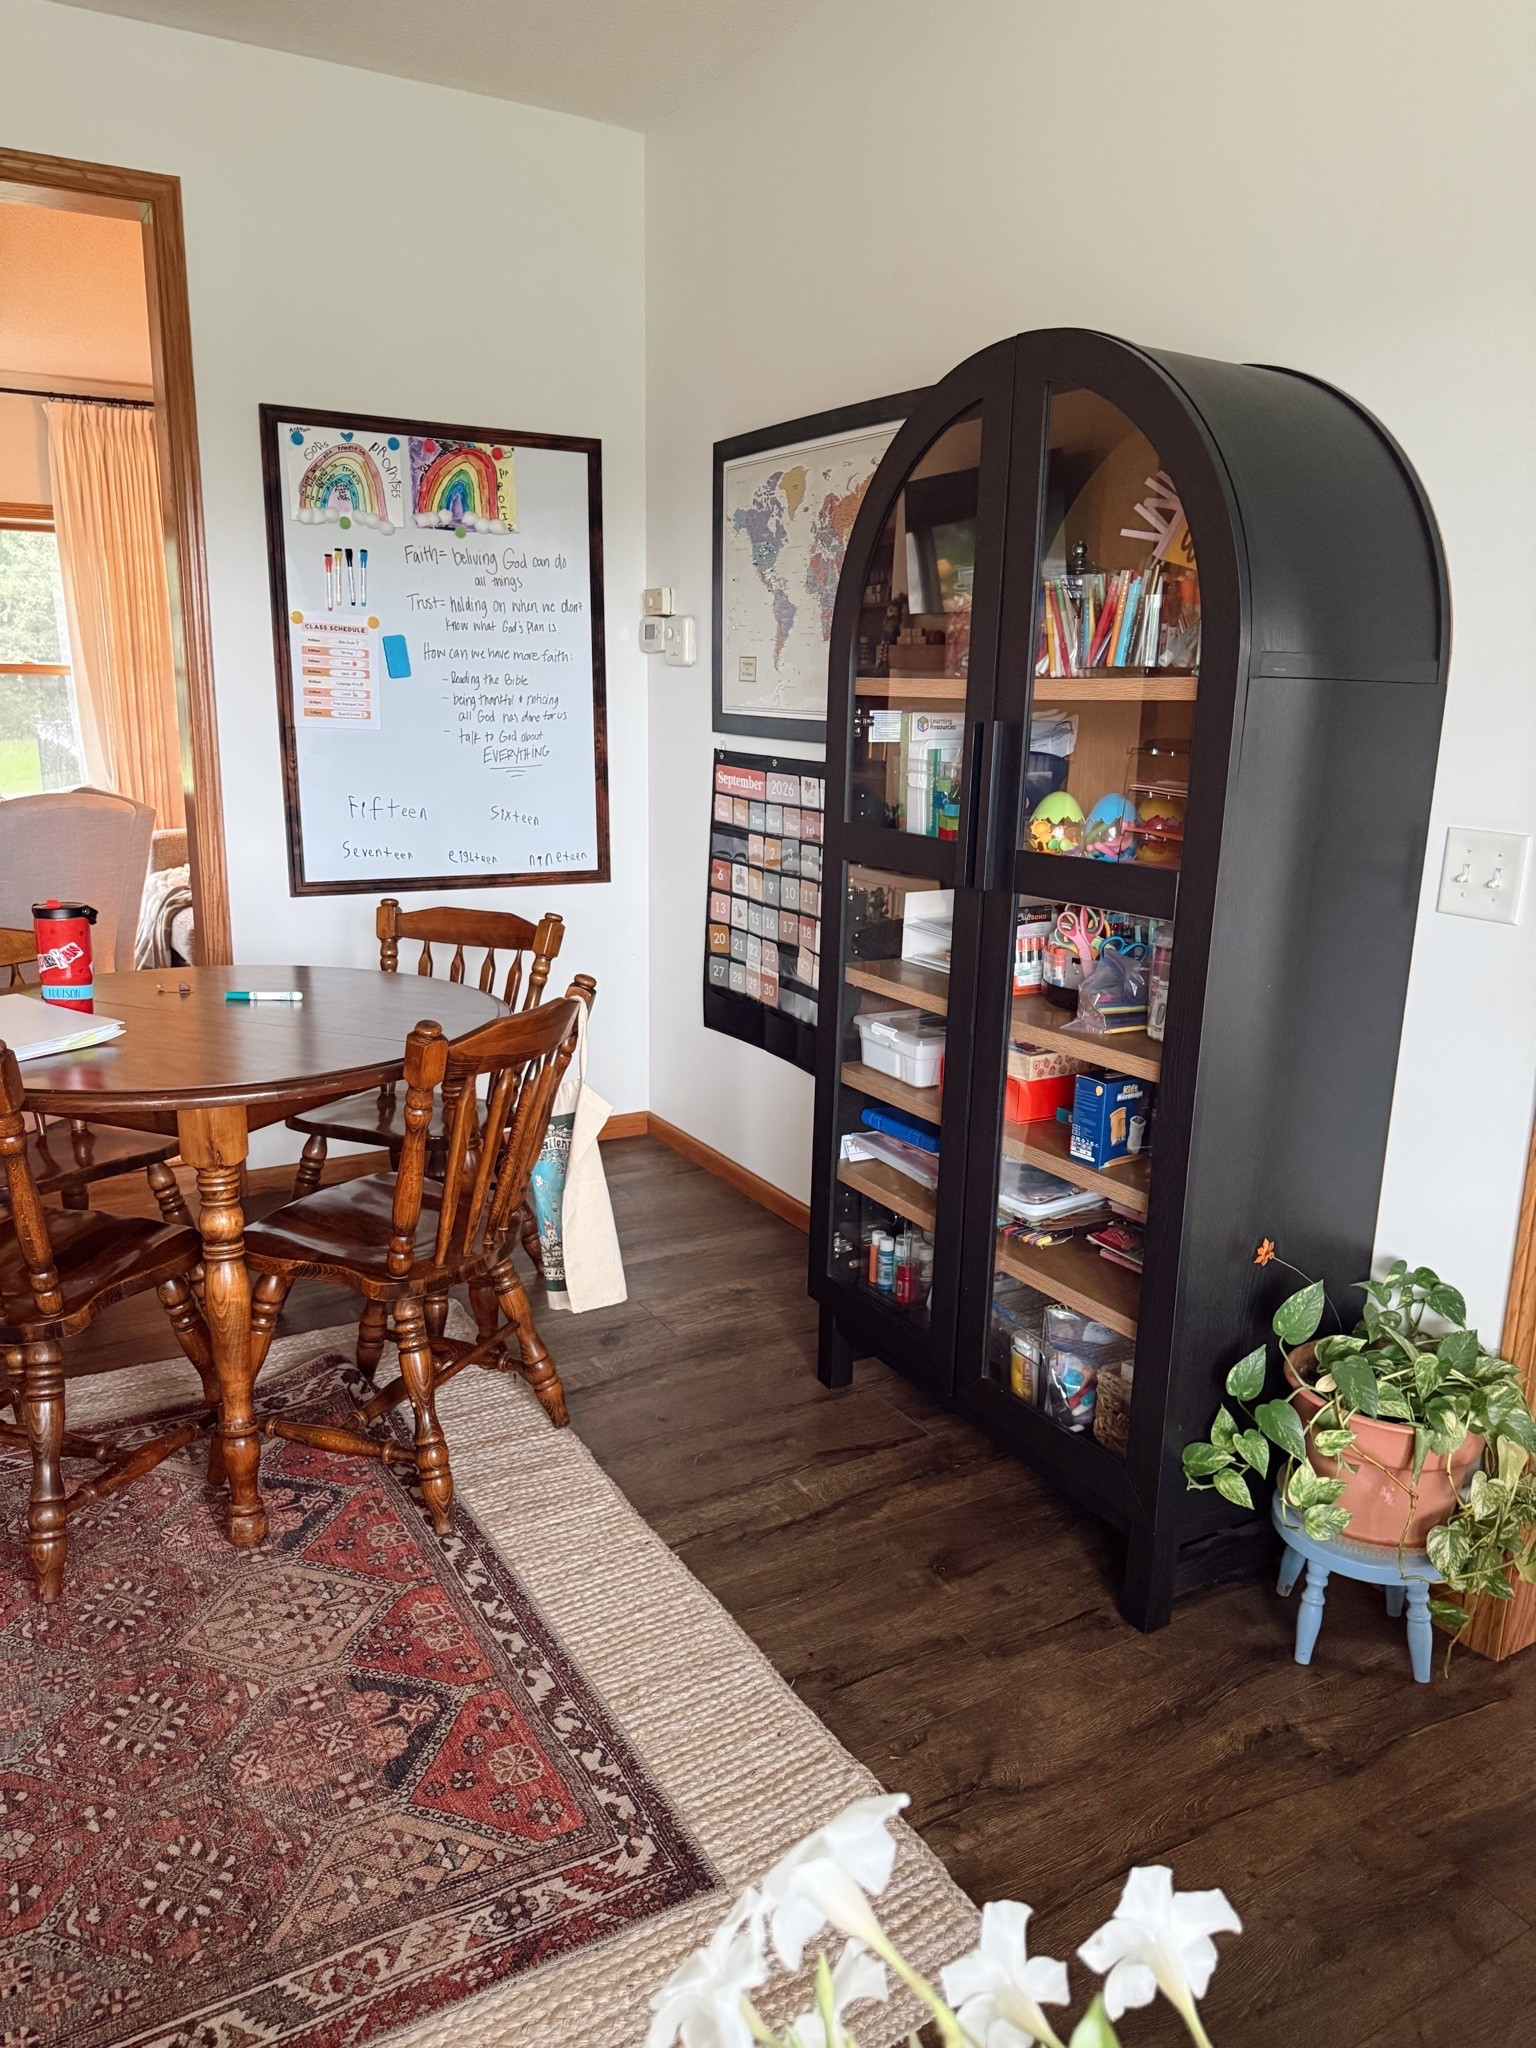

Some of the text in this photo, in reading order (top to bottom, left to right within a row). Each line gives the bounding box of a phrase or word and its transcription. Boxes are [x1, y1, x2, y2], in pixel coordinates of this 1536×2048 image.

[452, 547, 498, 575] beliving
[503, 548, 528, 570] God
[532, 558, 550, 568] can
[554, 554, 567, 569] do
[474, 576, 486, 586] all
[450, 596, 488, 618] holding
[493, 600, 506, 612] on
[512, 599, 538, 614] when
[542, 601, 556, 612] we
[330, 626, 366, 634] SCHEDULE
[474, 620, 496, 632] what
[502, 620, 523, 634] God's
[424, 642, 446, 661] How
[450, 648, 468, 660] can
[472, 650, 486, 660] we
[488, 648, 510, 660] have
[514, 651, 540, 661] more
[484, 672, 500, 684] the
[504, 673, 528, 686] Bible
[526, 694, 560, 710] noticing
[458, 710, 568, 723] all God has done for us
[930, 718, 952, 726] Learning
[459, 728, 544, 744] talk to God about
[718, 771, 764, 792] September
[771, 780, 794, 797] 2026
[348, 796, 540, 826] Fifteen Sixteen
[768, 819, 780, 828] Wed
[806, 826, 815, 835] Fri
[342, 840, 414, 860] Seventeen
[528, 852, 588, 867] nineteen
[770, 848, 776, 860] 2
[788, 848, 794, 860] 3
[808, 856, 812, 866] 4
[718, 869, 814, 904] 6 8 9 10 11
[715, 901, 812, 940] 13 15 16 17 18
[714, 932, 726, 944] 20
[734, 938, 744, 952] 21
[749, 944, 758, 958] 22
[765, 949, 776, 962] 23
[714, 965, 774, 996] 27 28 29 30
